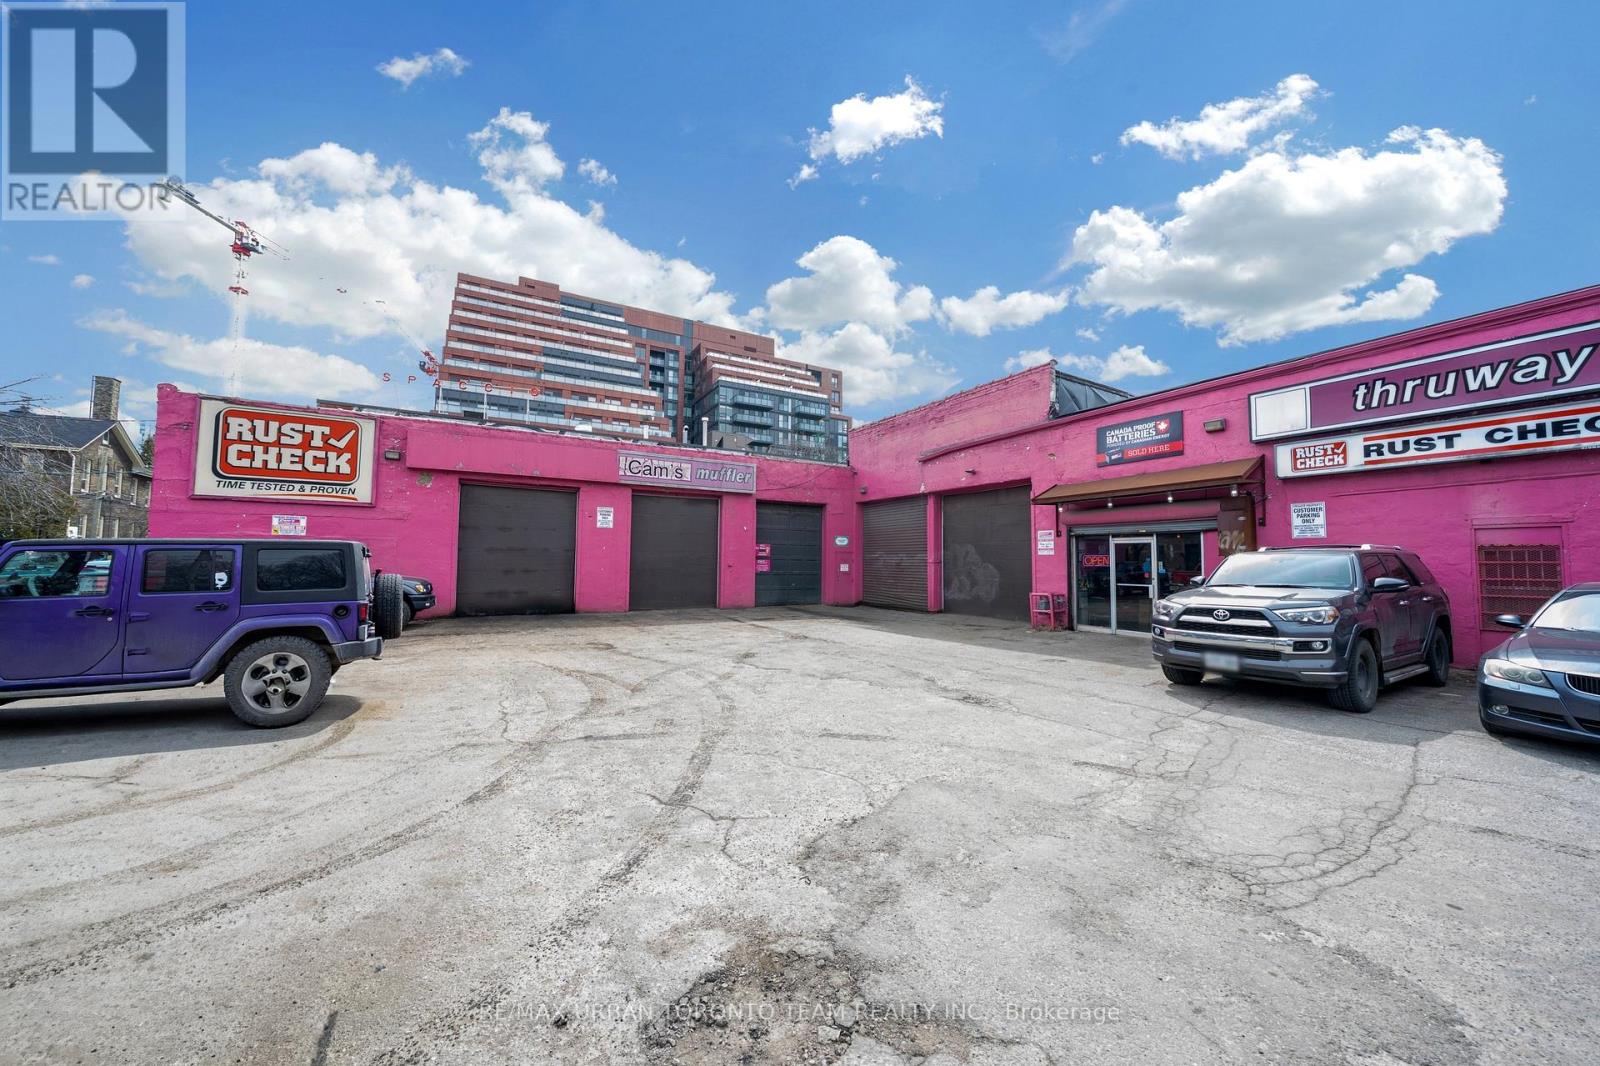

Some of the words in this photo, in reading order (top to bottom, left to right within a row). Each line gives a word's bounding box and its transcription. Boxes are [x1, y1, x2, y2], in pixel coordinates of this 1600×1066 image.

[1354, 345, 1598, 412] thruway
[226, 416, 331, 448] RUST
[1106, 426, 1132, 437] CANADA
[1133, 421, 1156, 432] PROOF
[1106, 428, 1156, 444] BATTERIES
[1127, 448, 1147, 457] SOLD
[1148, 444, 1170, 454] HERE
[1295, 444, 1334, 459] RUST
[1363, 432, 1462, 458] RUST
[226, 443, 352, 475] CHECK
[1296, 454, 1345, 469] CHECK
[628, 459, 683, 479] Cam's
[696, 466, 752, 483] muffler
[216, 480, 246, 490] TIME
[250, 482, 296, 492] TESTED
[298, 484, 306, 493] &
[310, 486, 357, 495] PROVEN
[1084, 556, 1110, 565] OPEN
